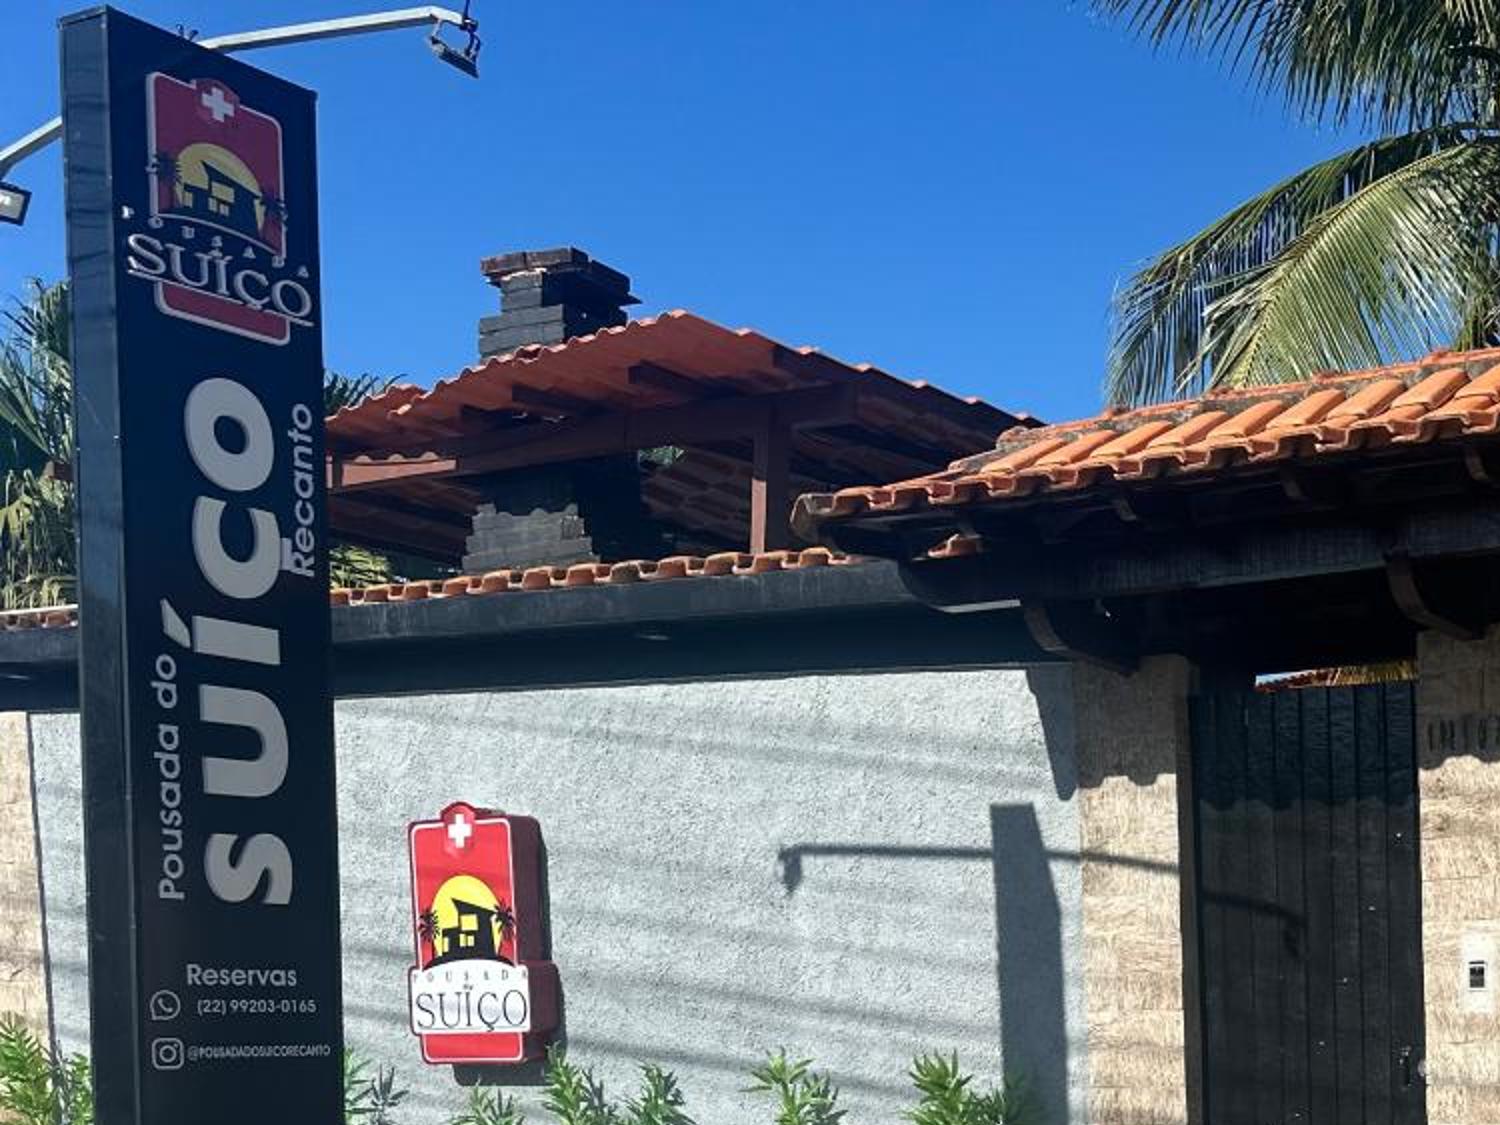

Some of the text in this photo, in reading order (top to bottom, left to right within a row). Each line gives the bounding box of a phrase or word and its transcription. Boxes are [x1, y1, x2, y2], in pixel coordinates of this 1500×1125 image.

[289, 402, 314, 577] Recanto
[150, 653, 185, 900] Pousada do
[186, 963, 298, 987] Reservas
[197, 999, 317, 1016] (22) 99203-0165
